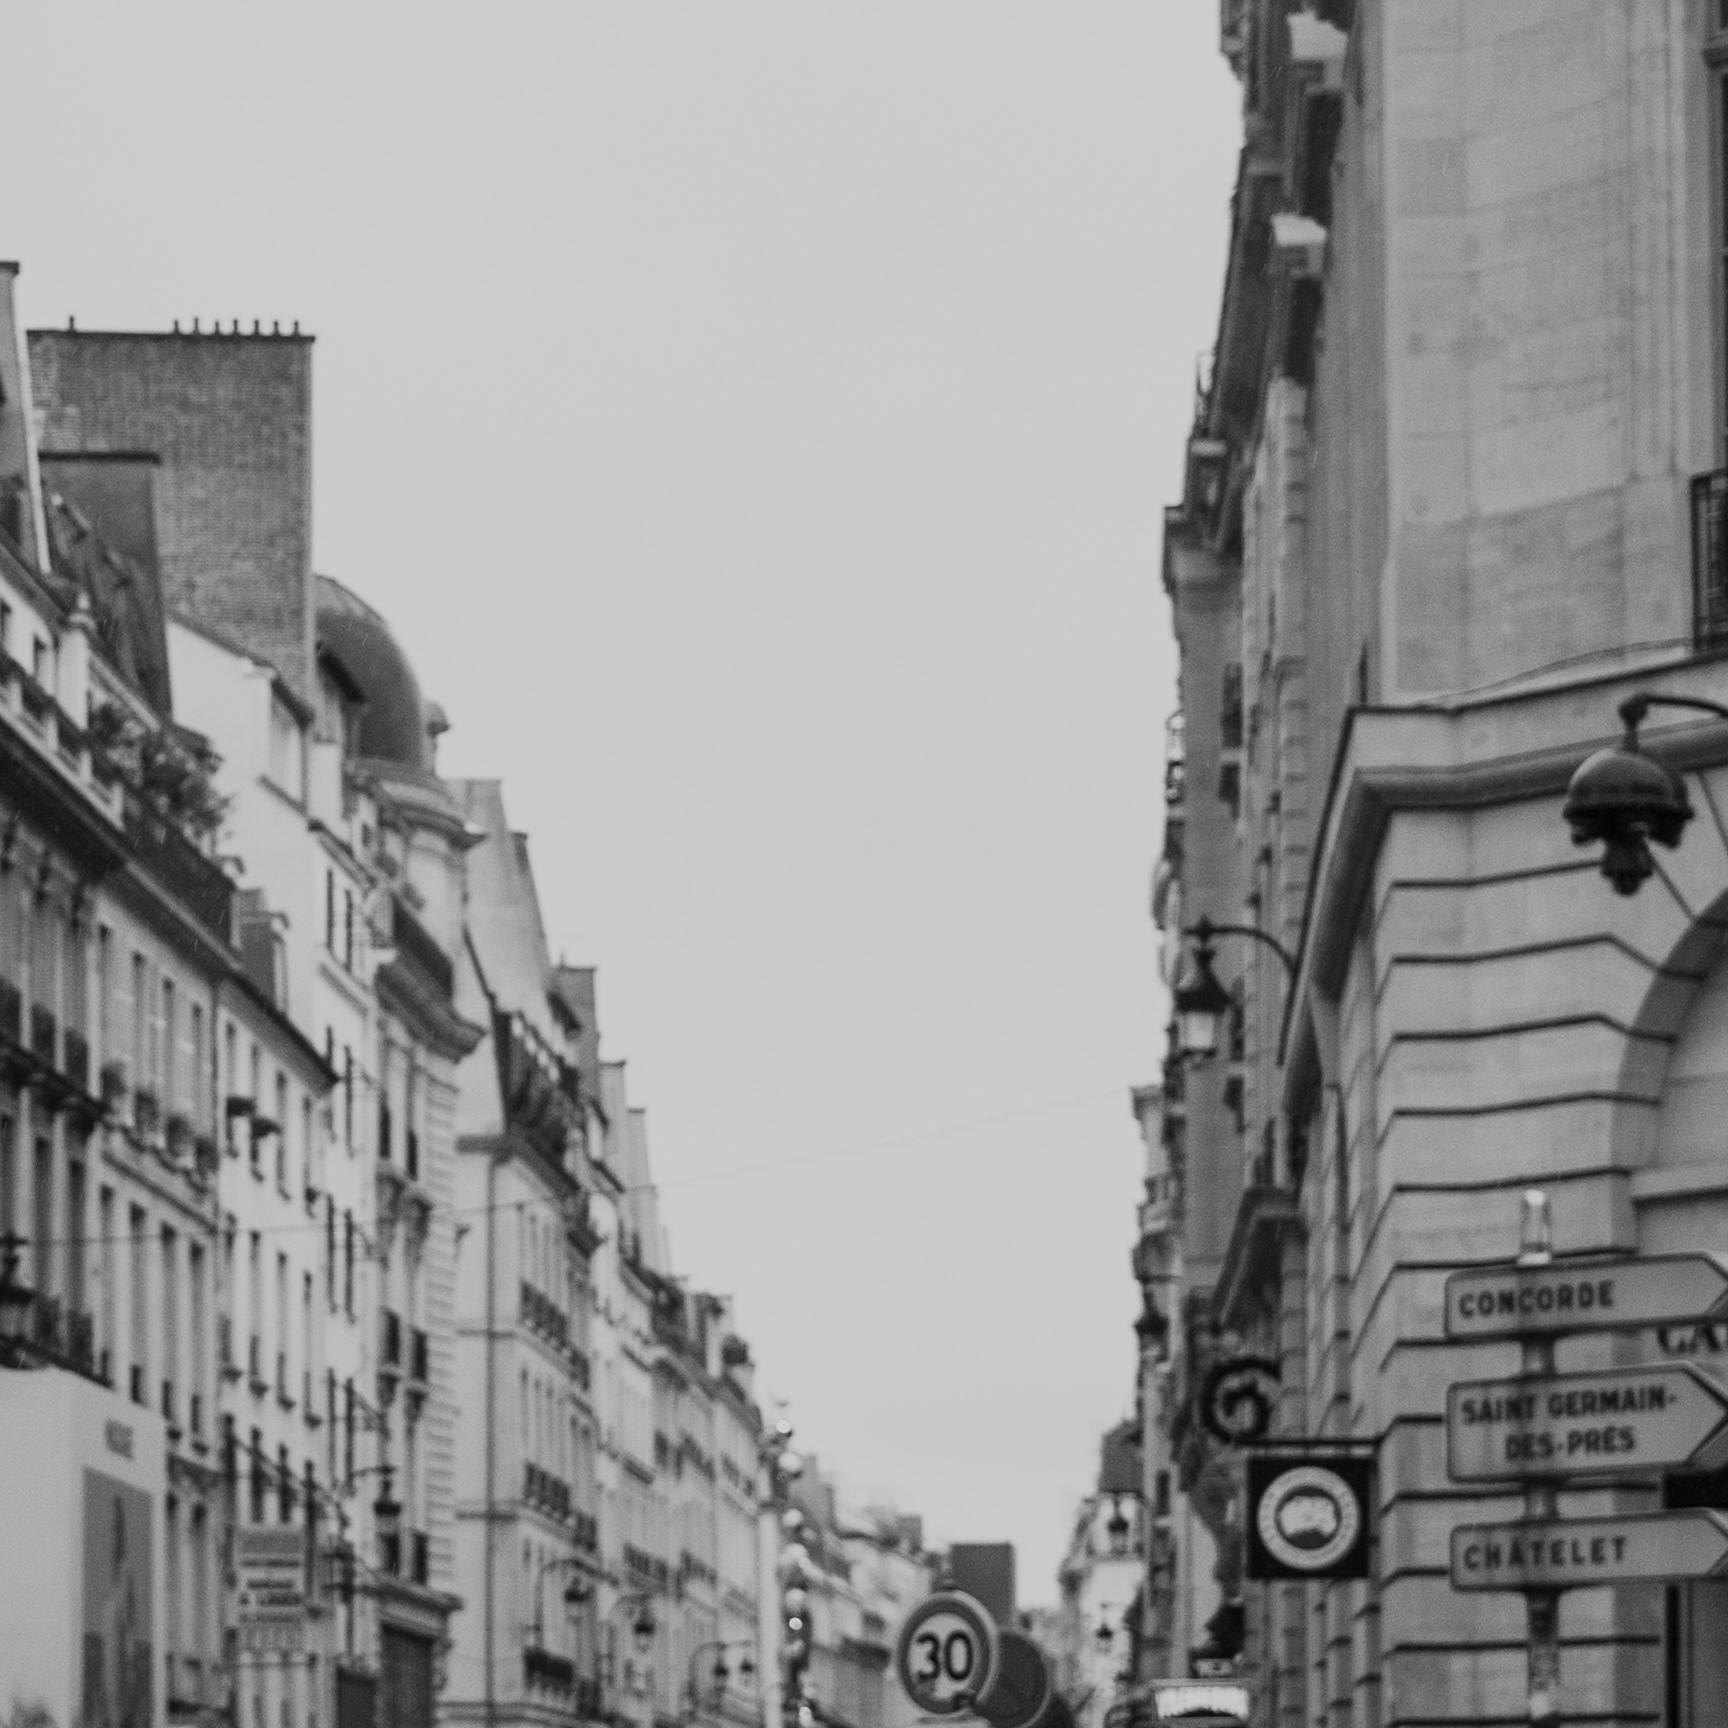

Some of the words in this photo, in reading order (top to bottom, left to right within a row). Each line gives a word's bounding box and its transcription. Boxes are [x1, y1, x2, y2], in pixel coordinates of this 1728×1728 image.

[1459, 1279, 1616, 1320] CONCORDE
[1462, 1394, 1534, 1425] SAINT
[1548, 1385, 1677, 1418] GERMAIN-
[1505, 1426, 1634, 1460] DES-PRÉS
[918, 1633, 974, 1681] 30
